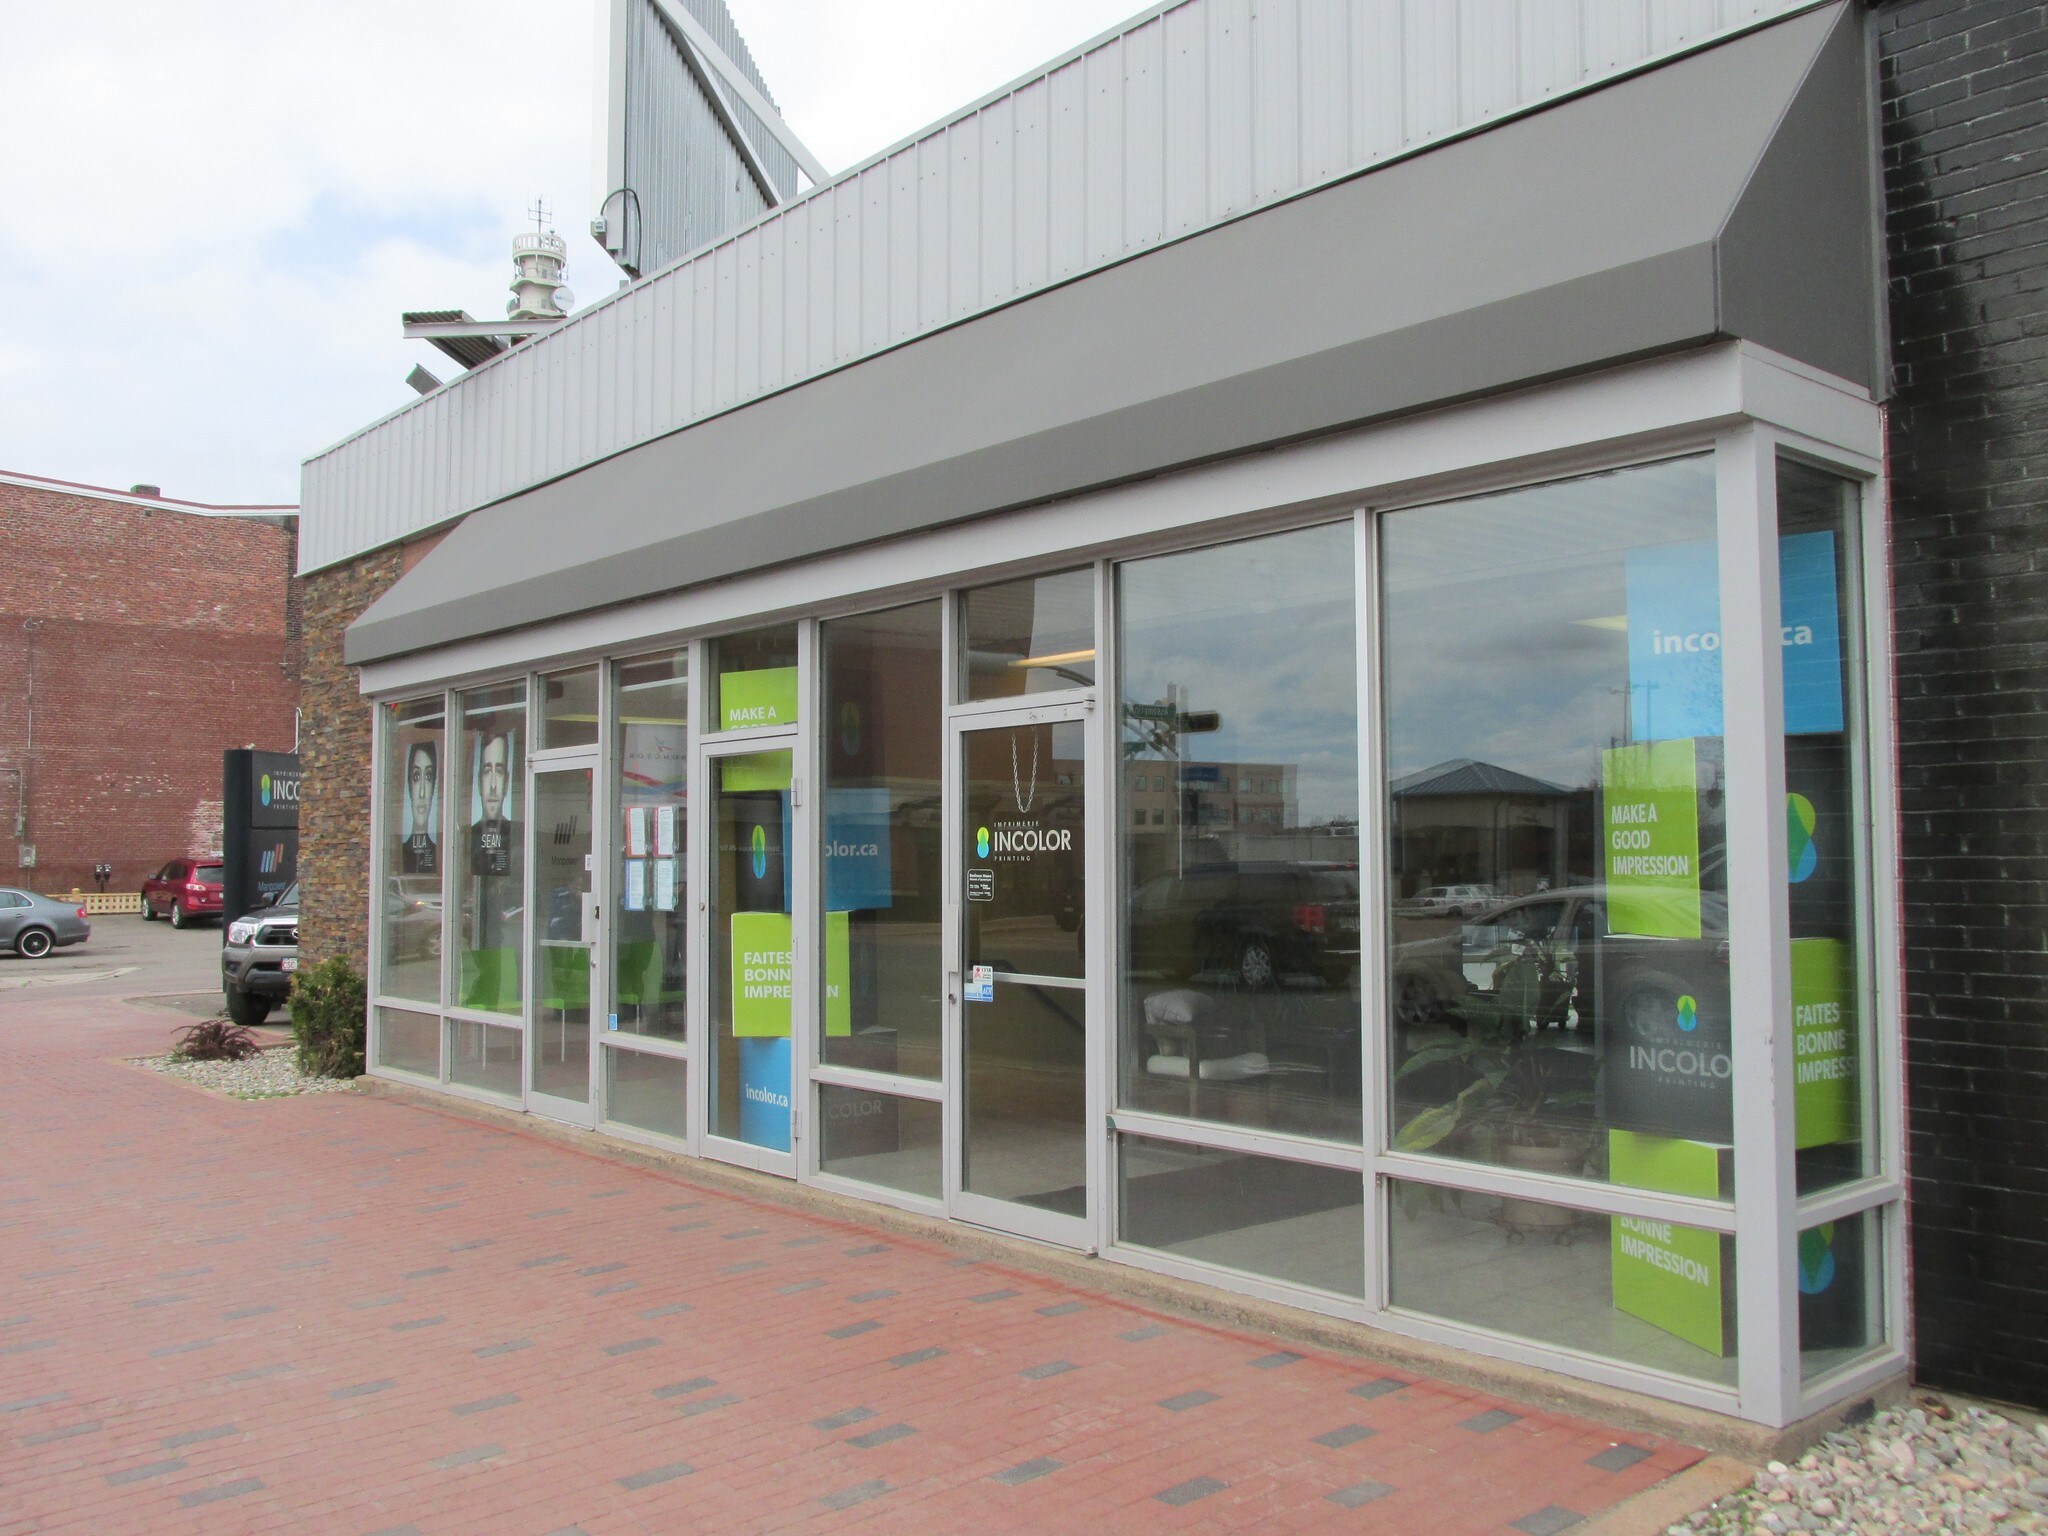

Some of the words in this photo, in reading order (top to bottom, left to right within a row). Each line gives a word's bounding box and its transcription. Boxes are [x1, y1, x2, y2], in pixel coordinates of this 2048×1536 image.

[1653, 624, 1813, 655] incoca
[729, 706, 765, 722] MAKE
[767, 705, 777, 719] A
[1611, 803, 1646, 824] MAKE
[1647, 803, 1658, 822] A
[412, 834, 427, 848] LILA
[481, 833, 502, 848] SEAN
[994, 829, 1072, 852] INCOLOR
[1612, 829, 1650, 850] GOOD
[1613, 855, 1690, 876] IMPRESSION
[743, 951, 792, 965] FAITES
[744, 985, 839, 999] IMPREN
[1796, 1002, 1840, 1027] FAITES
[1797, 1029, 1847, 1056] BONNE
[1630, 1045, 1732, 1078] INCOLO
[746, 1084, 788, 1108] incolor.ca
[1621, 1234, 1709, 1287] IMPRESSION
